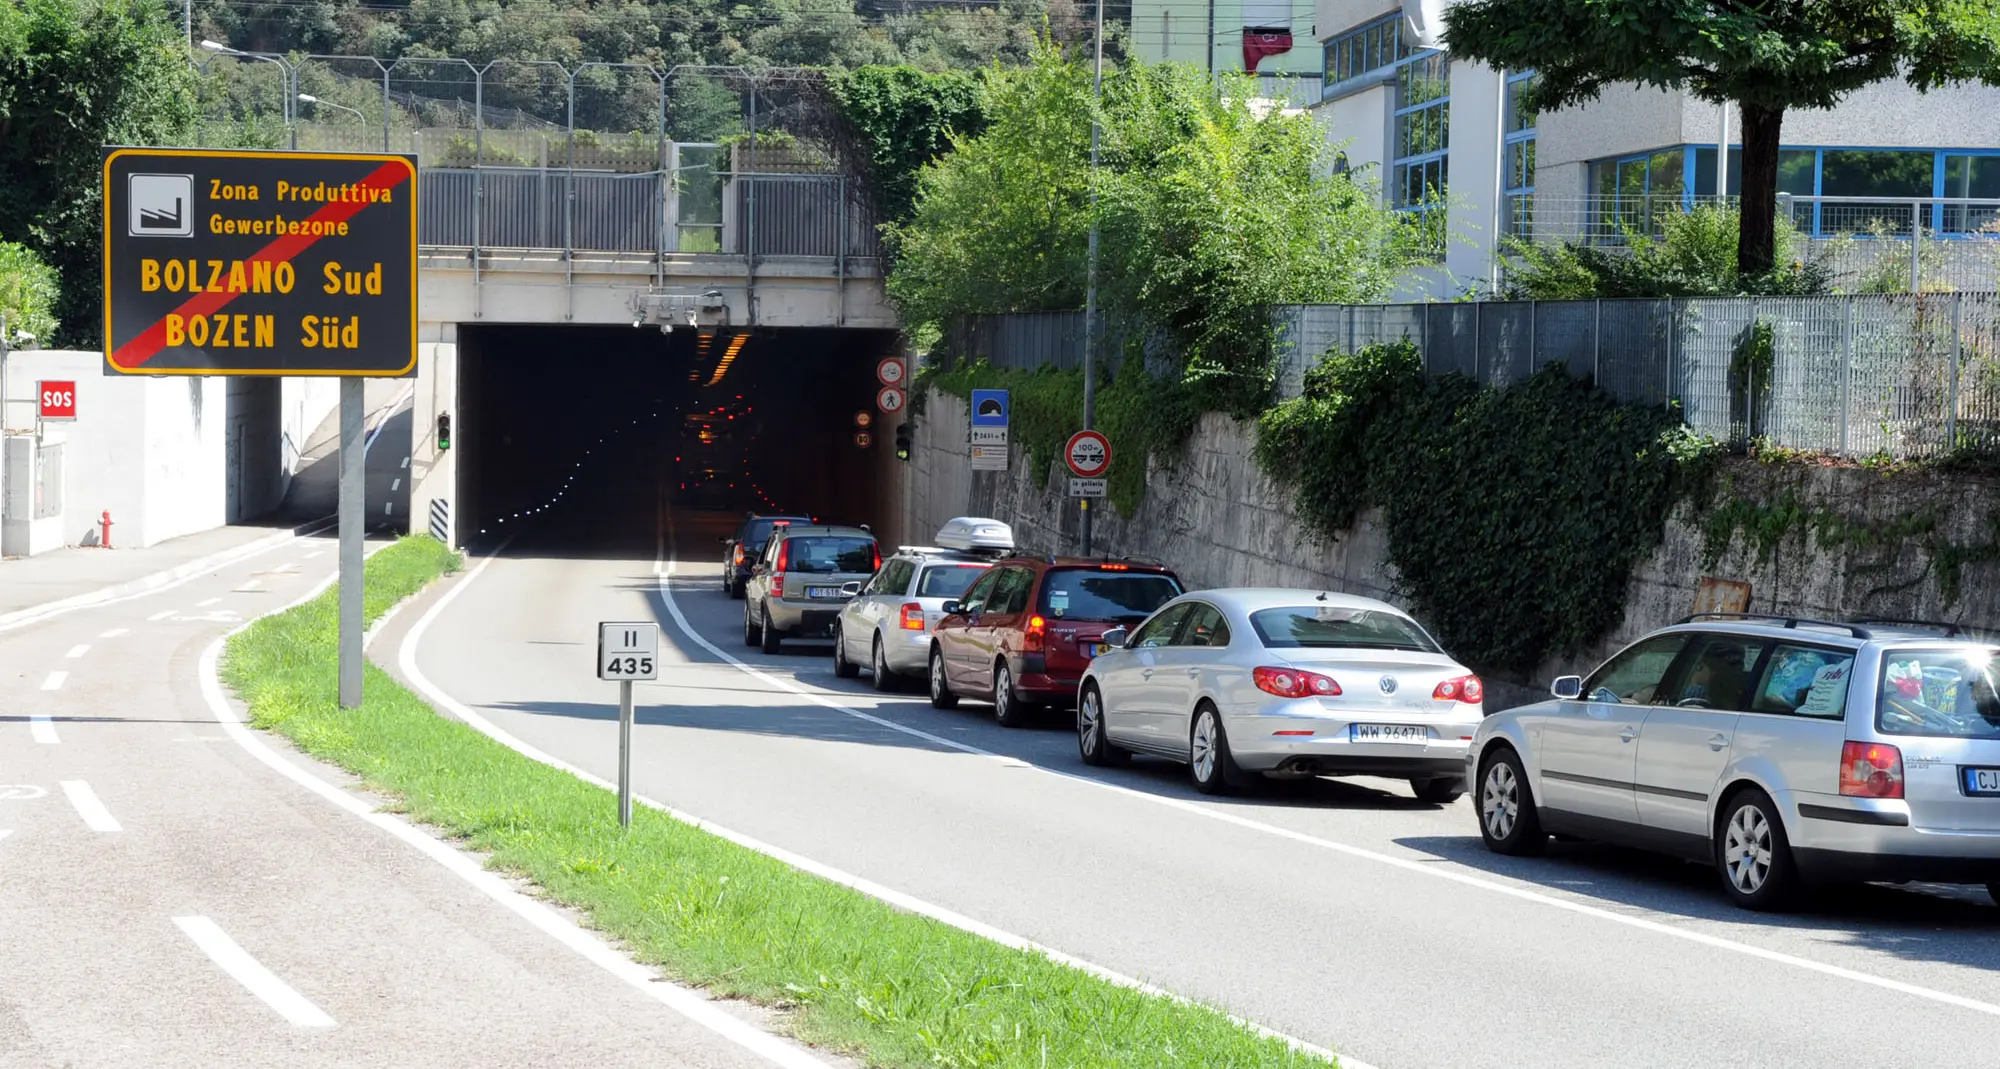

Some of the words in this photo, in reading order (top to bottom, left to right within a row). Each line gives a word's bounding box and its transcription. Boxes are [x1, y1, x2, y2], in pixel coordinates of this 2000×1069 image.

[209, 179, 260, 201] Zona
[277, 180, 392, 203] Produttiva
[209, 213, 349, 236] Gewerbezone
[141, 258, 296, 294] BOLZANO
[322, 261, 383, 295] Sud
[165, 313, 275, 348] BOZEN
[300, 315, 359, 349] Süd
[43, 391, 73, 407] SOS
[607, 657, 653, 675] 435
[1360, 725, 1379, 739] WW
[1384, 726, 1425, 741] 9647U
